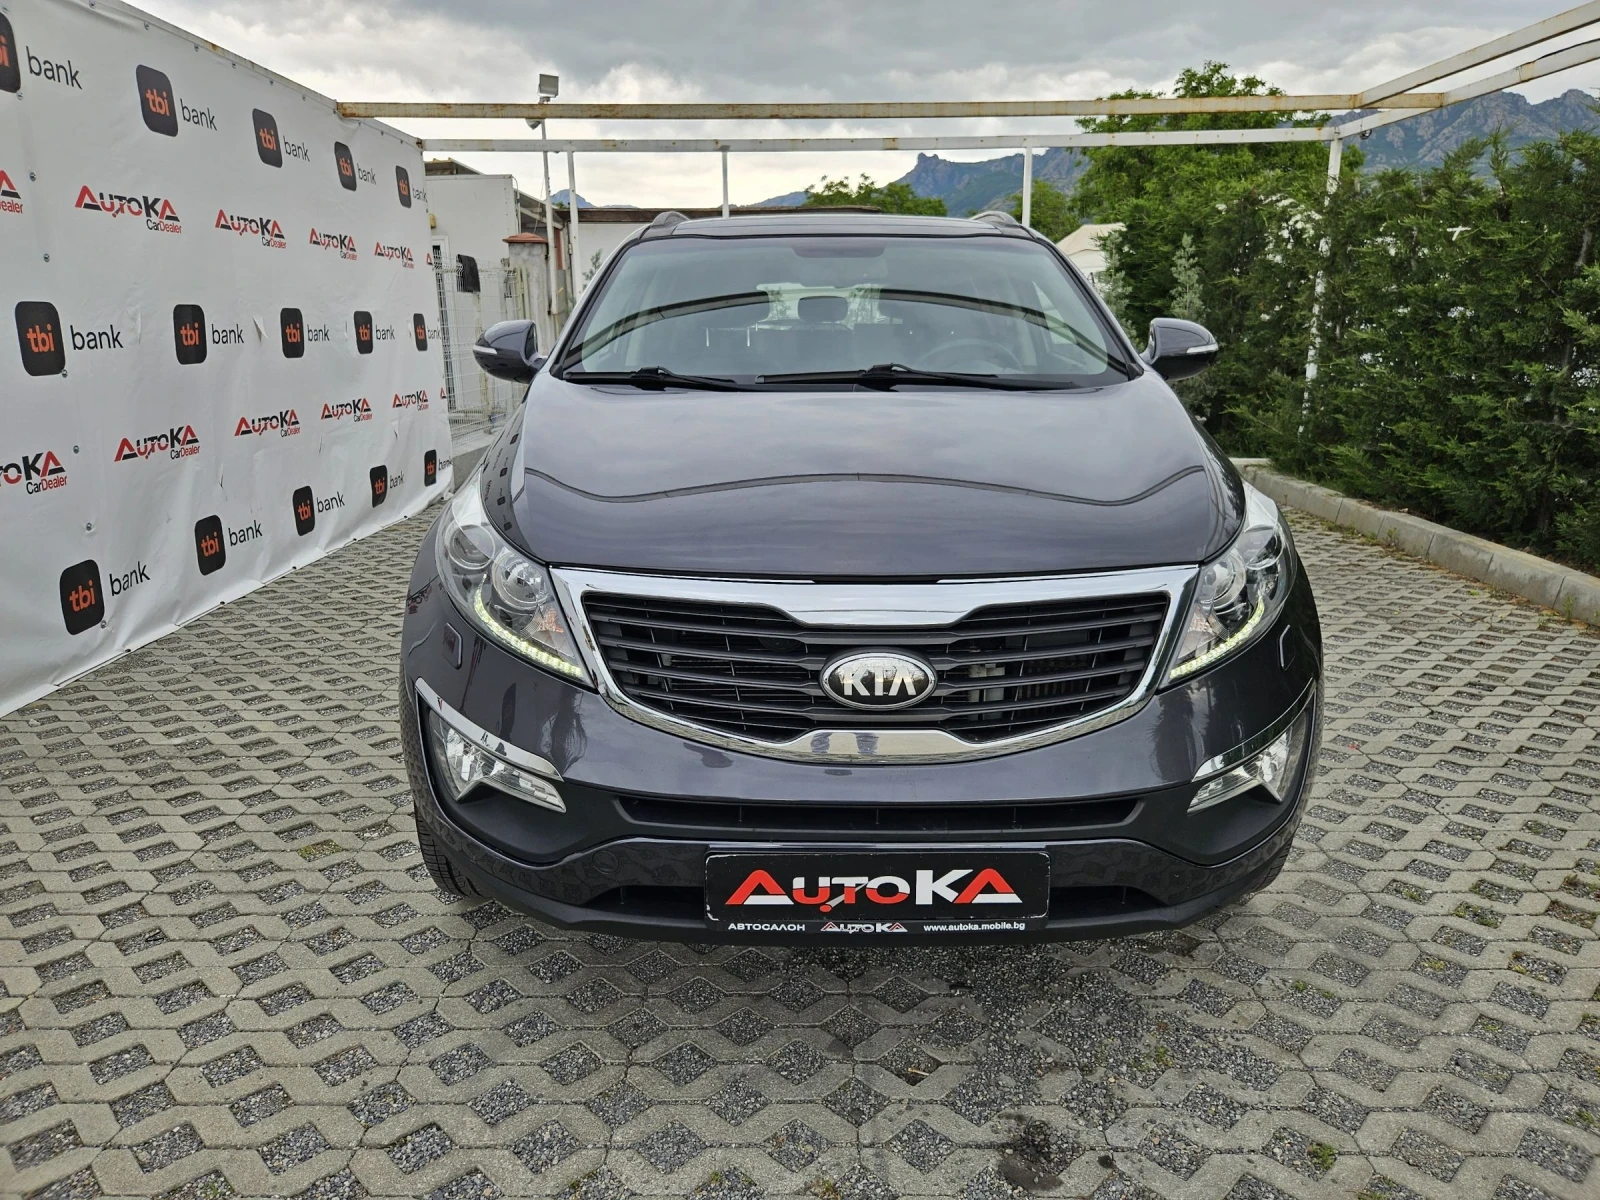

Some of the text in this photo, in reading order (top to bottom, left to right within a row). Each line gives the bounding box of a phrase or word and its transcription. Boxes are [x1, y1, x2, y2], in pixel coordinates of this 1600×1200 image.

[26, 46, 82, 90] bank
[146, 88, 218, 131] tbi bank
[259, 128, 310, 162] tbi bank
[339, 157, 377, 185] tbi bank
[399, 179, 409, 197] tbi
[146, 218, 182, 234] CarDealer
[261, 236, 287, 249] CarDealer
[27, 323, 124, 353] tbi bank
[180, 322, 244, 346] tbi bank
[285, 323, 330, 343] tbi bank
[359, 324, 395, 341] tbi bank
[416, 325, 425, 340] tbi
[280, 426, 301, 438] CarDealer
[170, 445, 201, 460] CarDealer
[427, 460, 435, 476] tbi
[26, 475, 67, 495] CarDealer
[374, 470, 405, 495] tbi bank
[297, 491, 346, 521] tbi bank
[201, 519, 263, 557] tbi bank
[69, 561, 150, 612] tbi bank
[842, 665, 917, 697] KIA
[725, 868, 1023, 913] AUTOKA
[727, 922, 806, 932] АВТОСАЛОН
[923, 921, 1026, 933] www.autoka.mobile.bg
